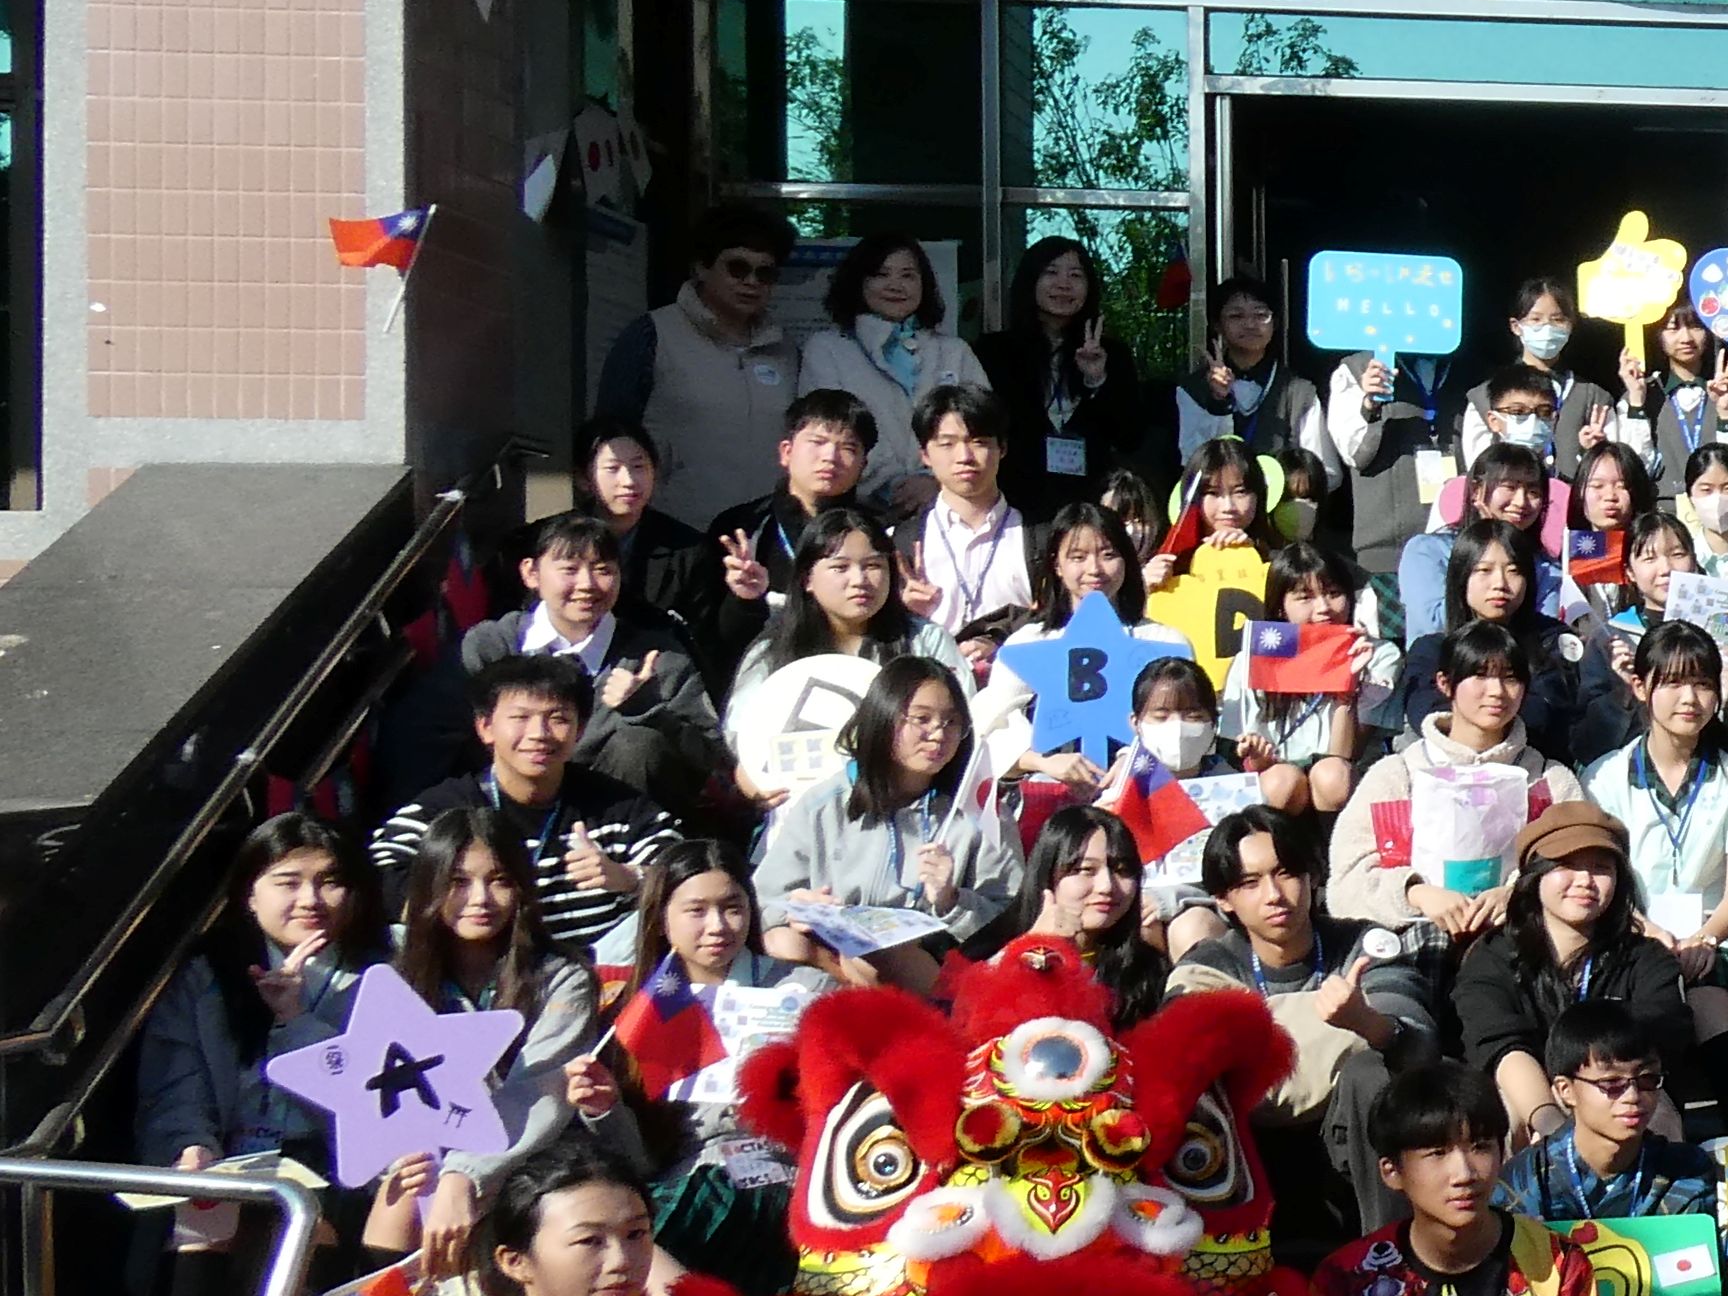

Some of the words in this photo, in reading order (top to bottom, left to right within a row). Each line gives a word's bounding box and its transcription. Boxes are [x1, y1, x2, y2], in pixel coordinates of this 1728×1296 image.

[1336, 297, 1440, 318] HELLO
[1067, 647, 1109, 703] B
[365, 1041, 446, 1119] A
